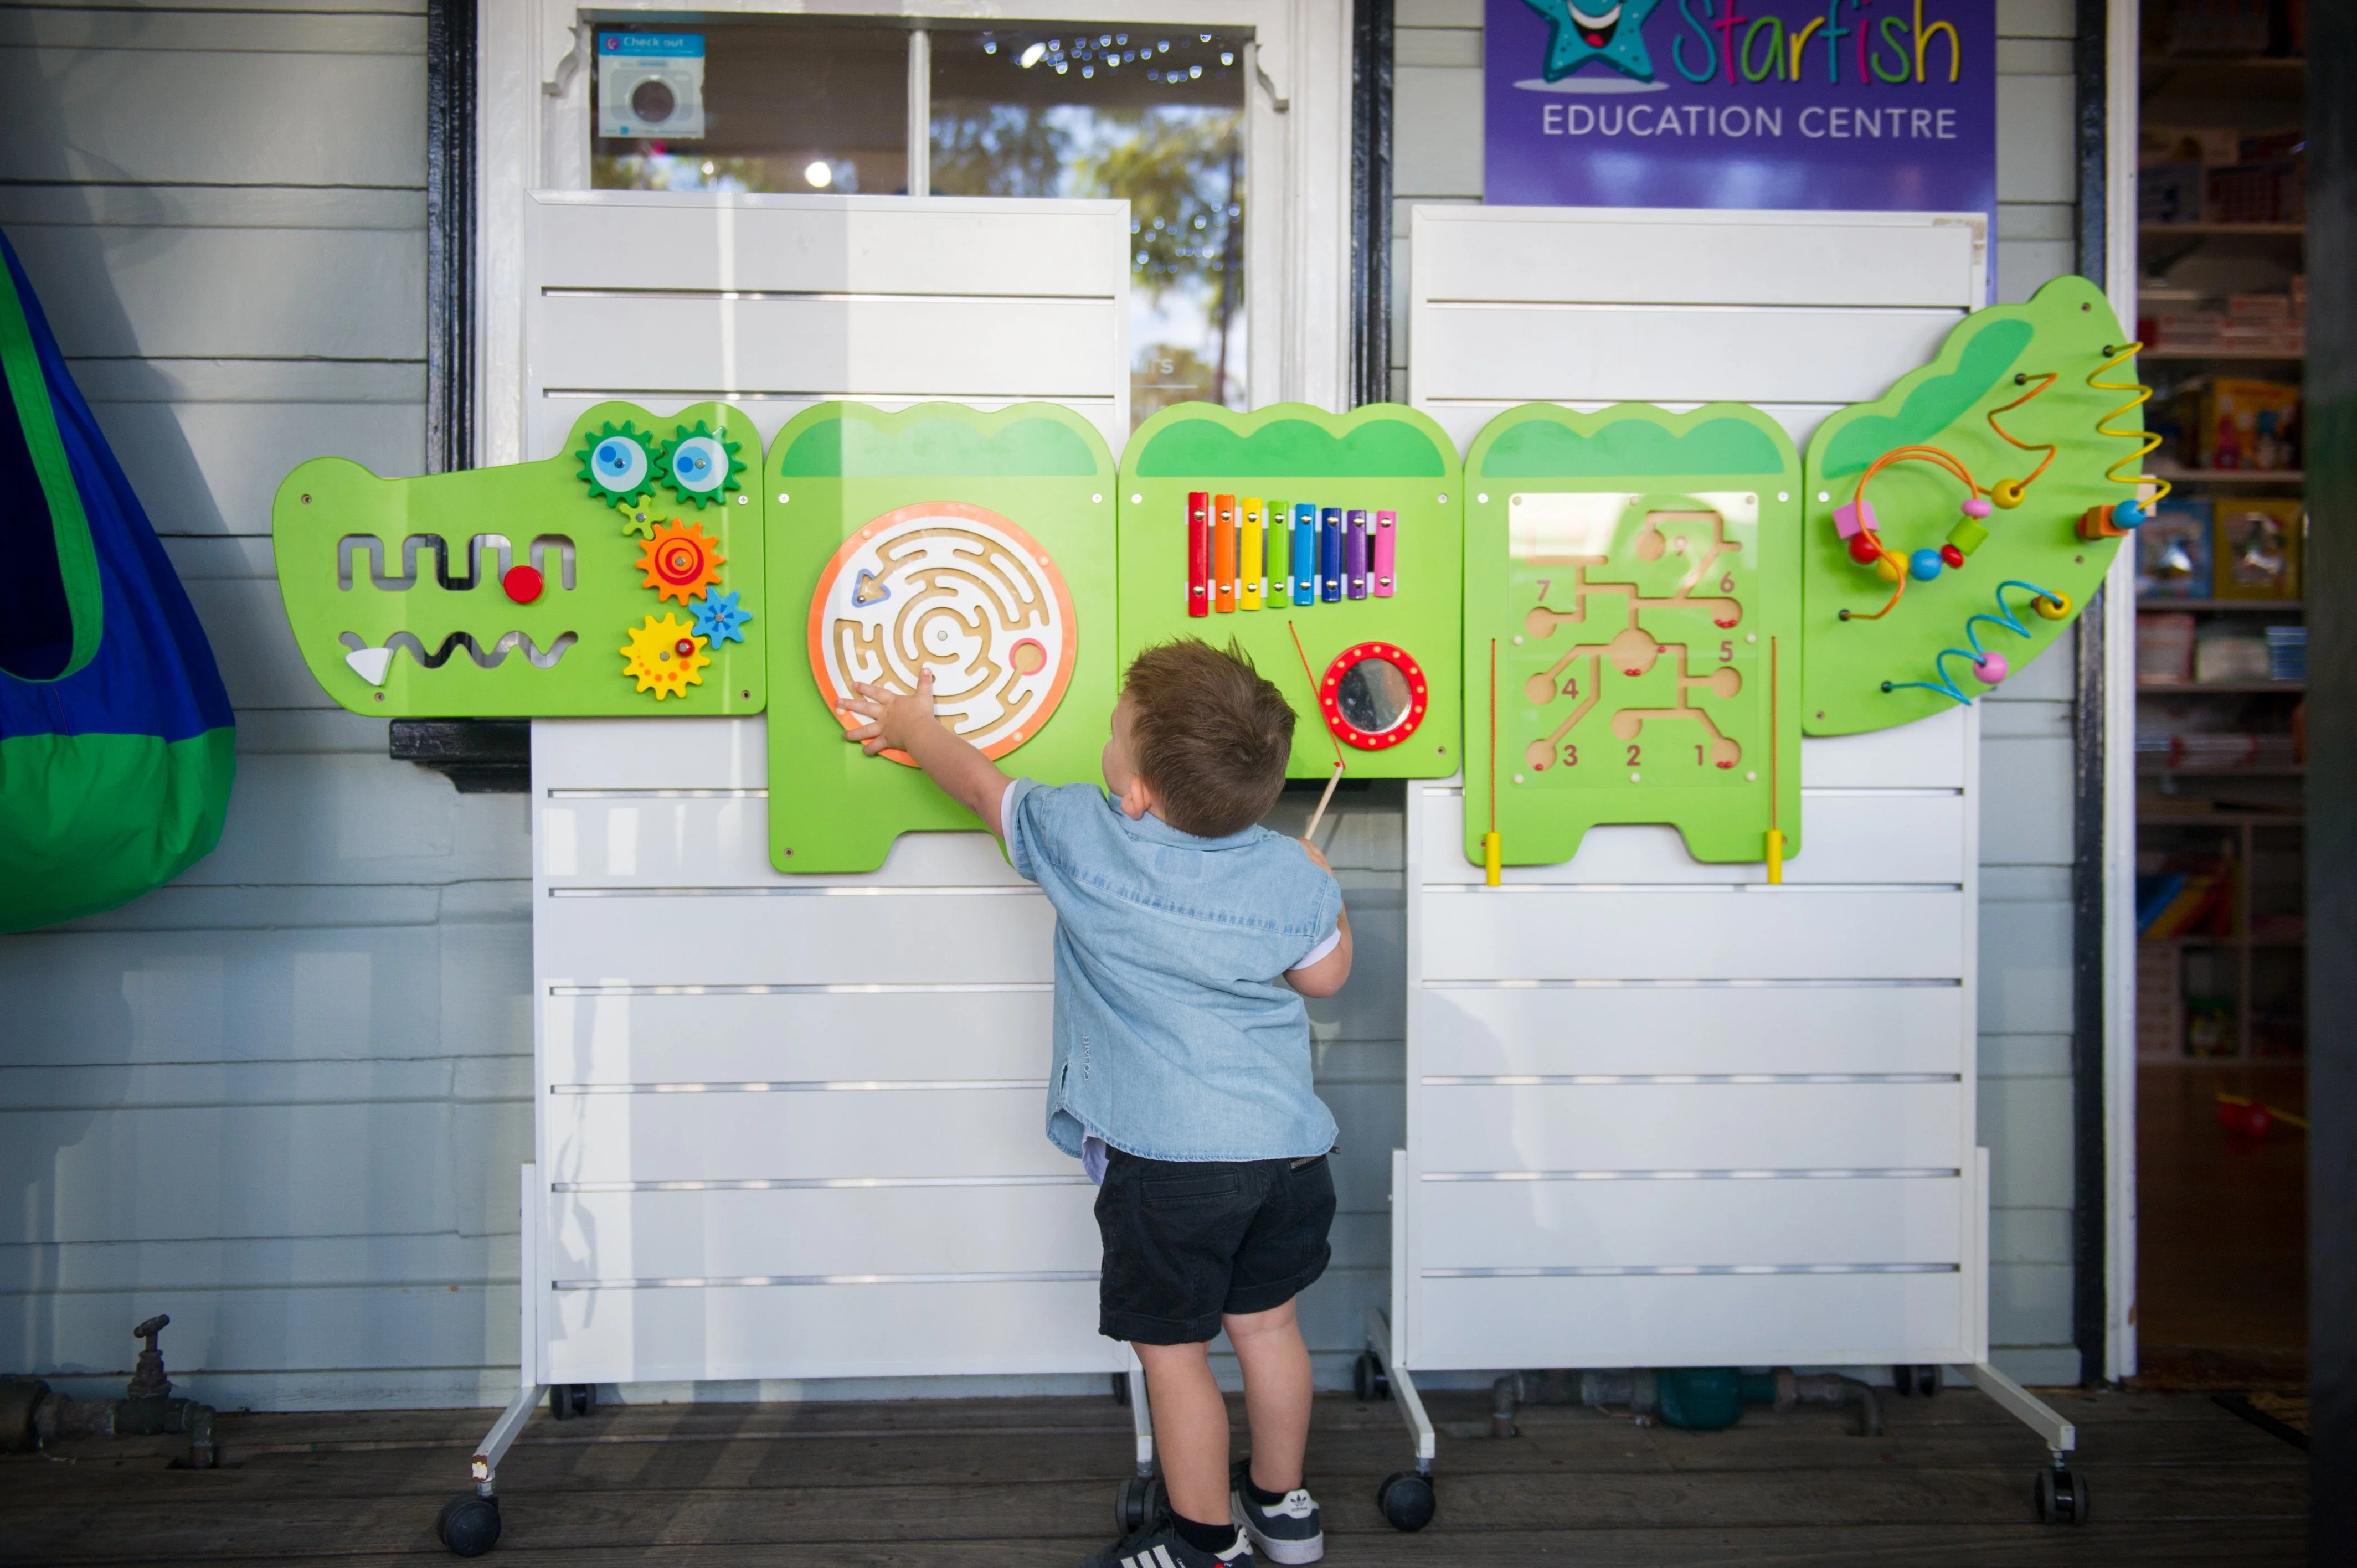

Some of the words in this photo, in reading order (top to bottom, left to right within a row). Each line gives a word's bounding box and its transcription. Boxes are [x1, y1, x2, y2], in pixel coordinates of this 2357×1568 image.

[624, 37, 659, 46] Check
[663, 38, 683, 47] out
[1672, 0, 1960, 84] Starfish
[1542, 104, 1782, 137] EDUCATION
[1798, 107, 1957, 139] CENTRE
[1673, 535, 1688, 556] 9
[1536, 580, 1551, 602] 7
[1720, 572, 1735, 593] 6
[1718, 641, 1734, 663] 5
[1561, 678, 1579, 700] 4
[1562, 744, 1578, 766] 3
[1626, 745, 1641, 766] 2
[1694, 745, 1704, 766] 1
